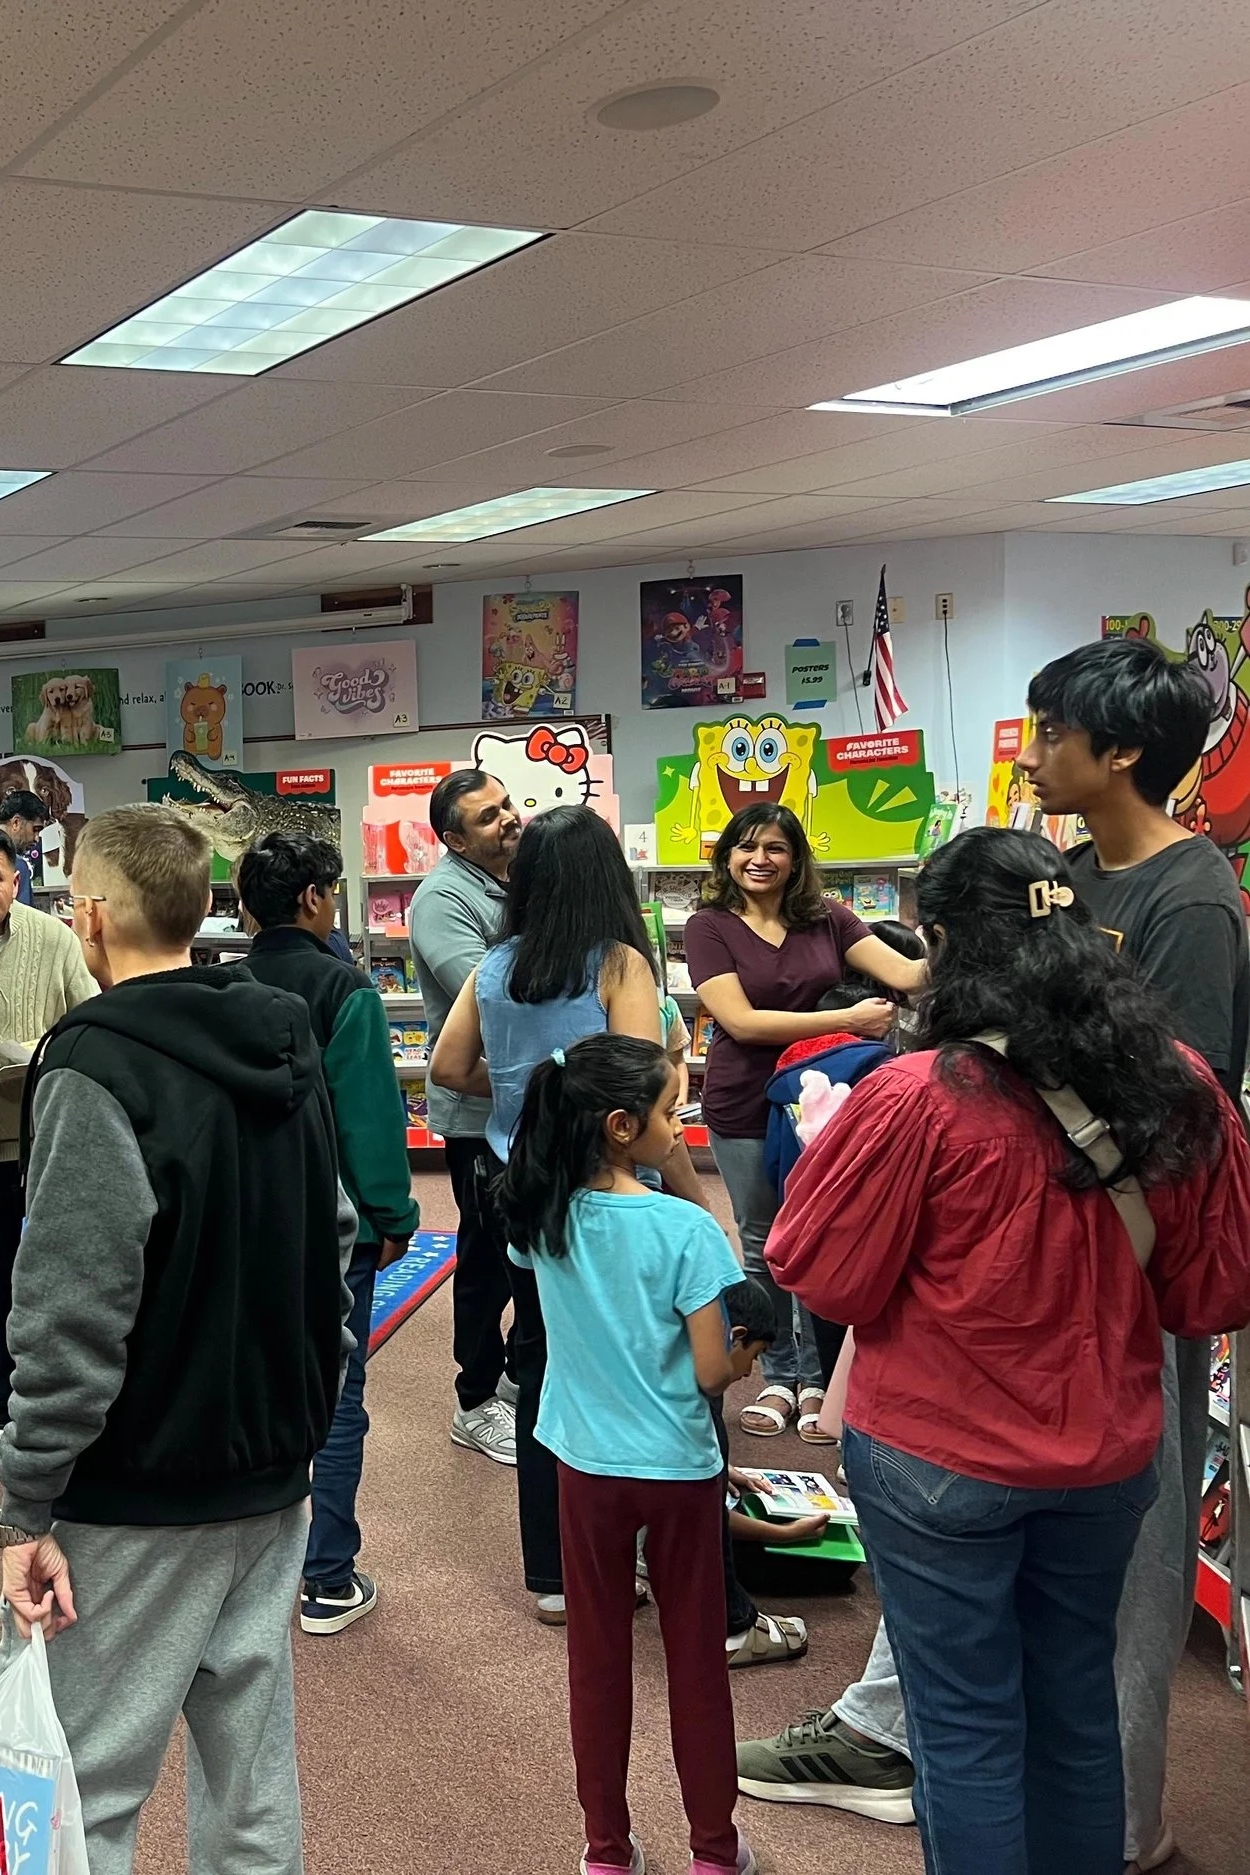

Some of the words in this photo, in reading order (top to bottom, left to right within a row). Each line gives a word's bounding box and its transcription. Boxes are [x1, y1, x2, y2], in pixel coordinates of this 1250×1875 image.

[1105, 619, 1127, 631] 100-
[792, 664, 830, 674] POSTERS
[320, 668, 389, 702] Good
[801, 676, 824, 685] $5.99
[242, 681, 281, 696] OOK.
[132, 692, 157, 704] relax,
[395, 714, 408, 723] A3
[846, 737, 900, 751] FAVORITE
[836, 746, 910, 760] CHARACTERS
[282, 775, 298, 784] FUN
[299, 773, 325, 783] FACTS
[389, 768, 435, 777] FAVORITE
[380, 776, 443, 786] CHARACTERS
[638, 831, 648, 843] 4
